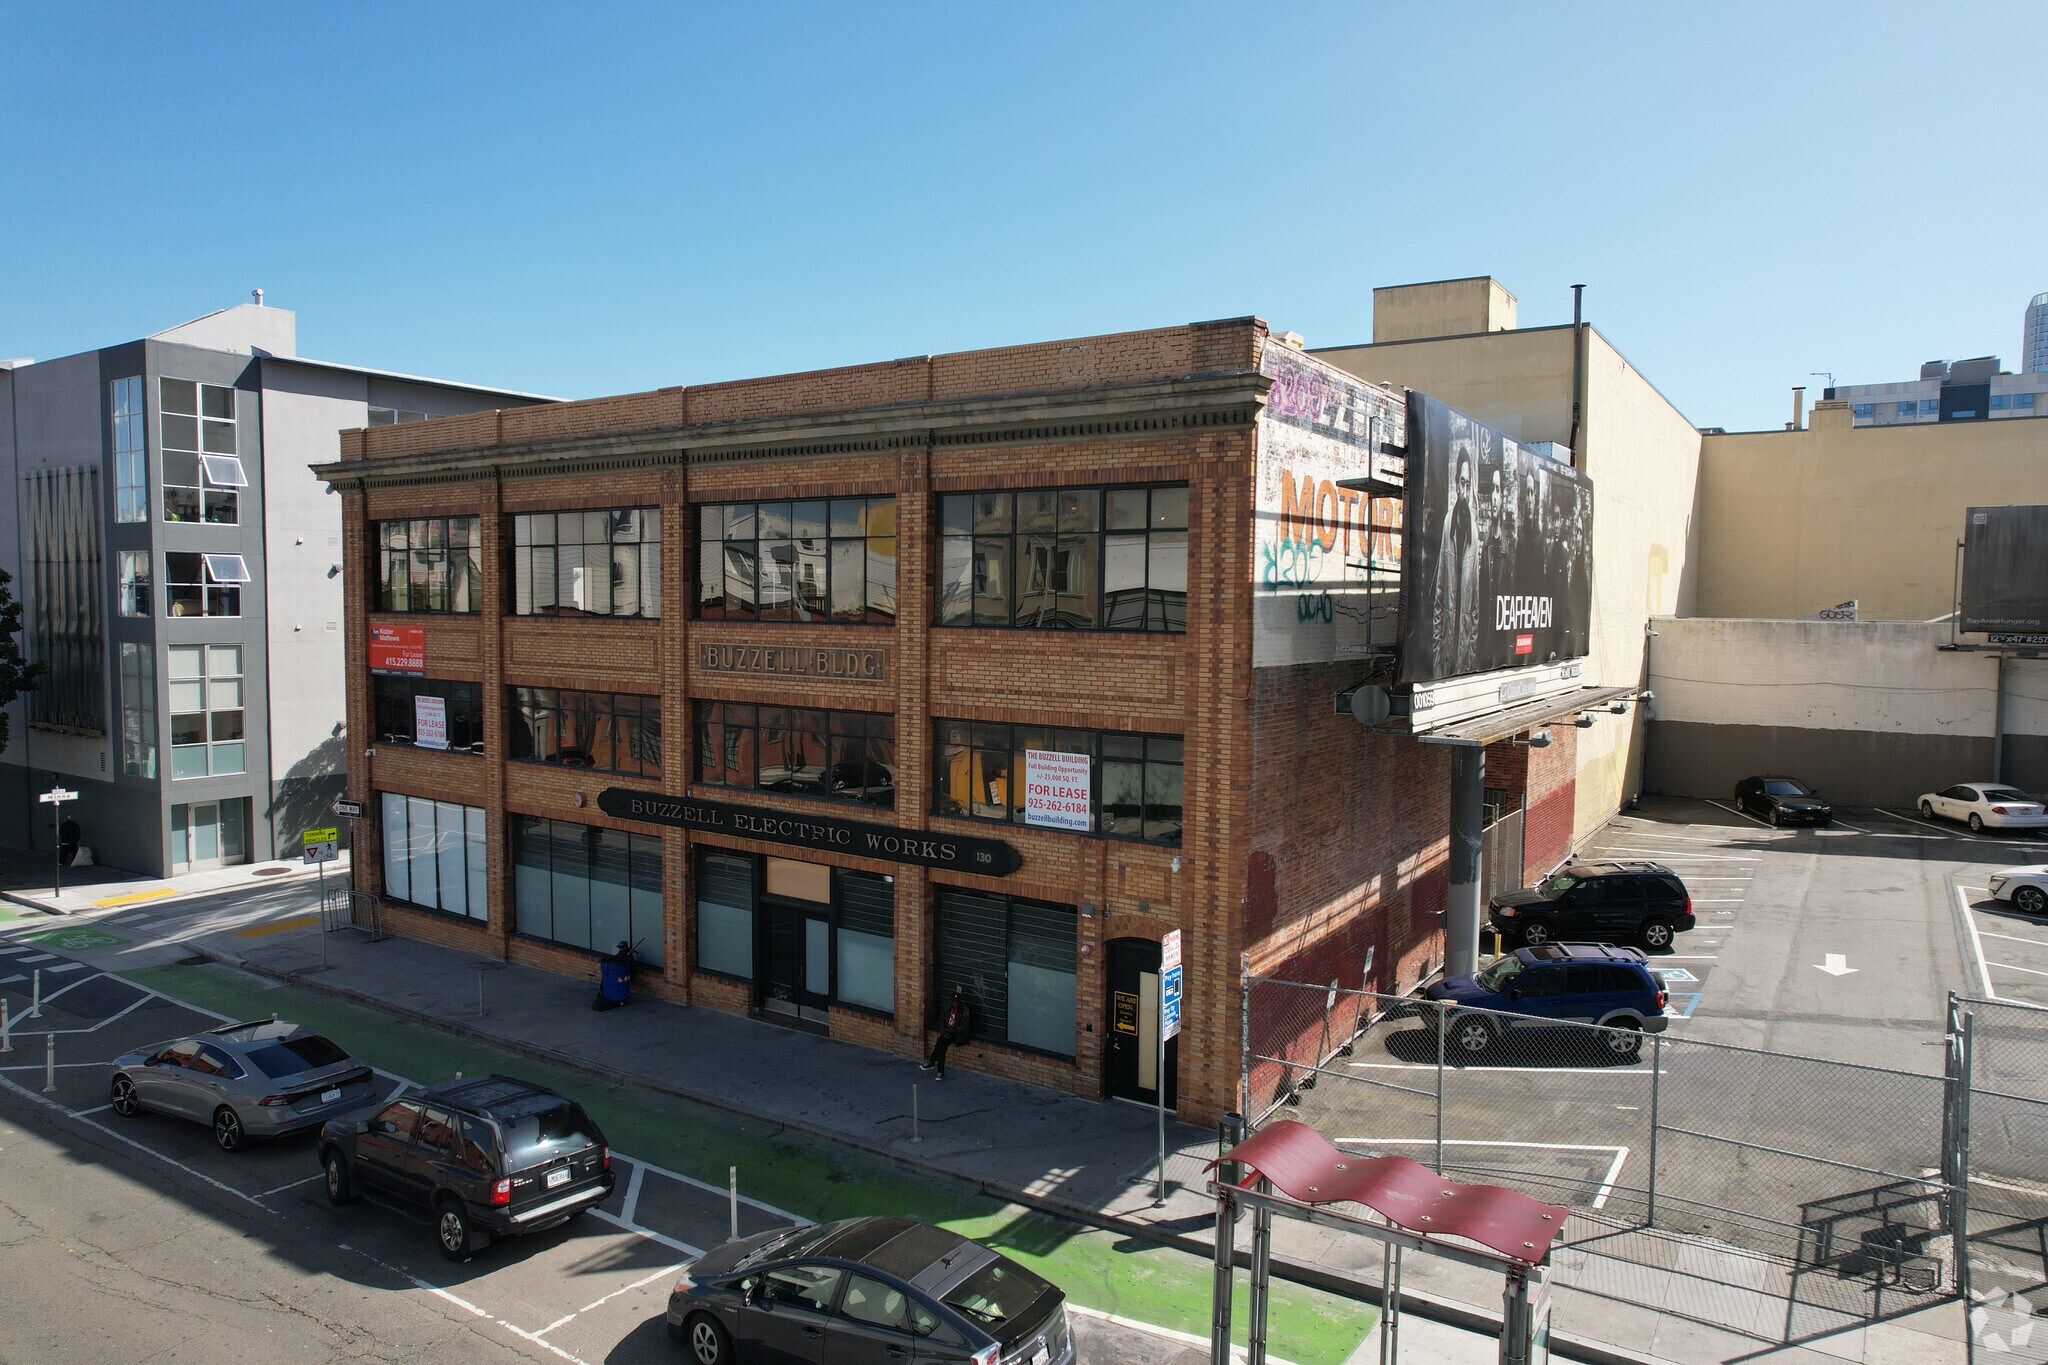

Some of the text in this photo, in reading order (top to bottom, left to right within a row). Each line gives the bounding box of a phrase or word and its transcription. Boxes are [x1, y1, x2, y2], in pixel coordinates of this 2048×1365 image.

[1496, 595, 1553, 631] DEAFHEAVEN
[707, 647, 876, 676] BUZZELL BLDG
[418, 719, 445, 729] FOR LEASE
[1028, 752, 1088, 765] THE BUZZELL BUILDING
[1038, 763, 1057, 773] Building
[1058, 766, 1088, 775] Opportunity
[1028, 784, 1087, 800] FOR LEASE
[1028, 797, 1087, 814] 925-262-6184
[1028, 813, 1087, 827] buzzellbuilding.com
[305, 830, 326, 838] TURNING
[631, 799, 956, 861] BUZZELL ELECTRIC WORKS
[976, 852, 992, 864] 130
